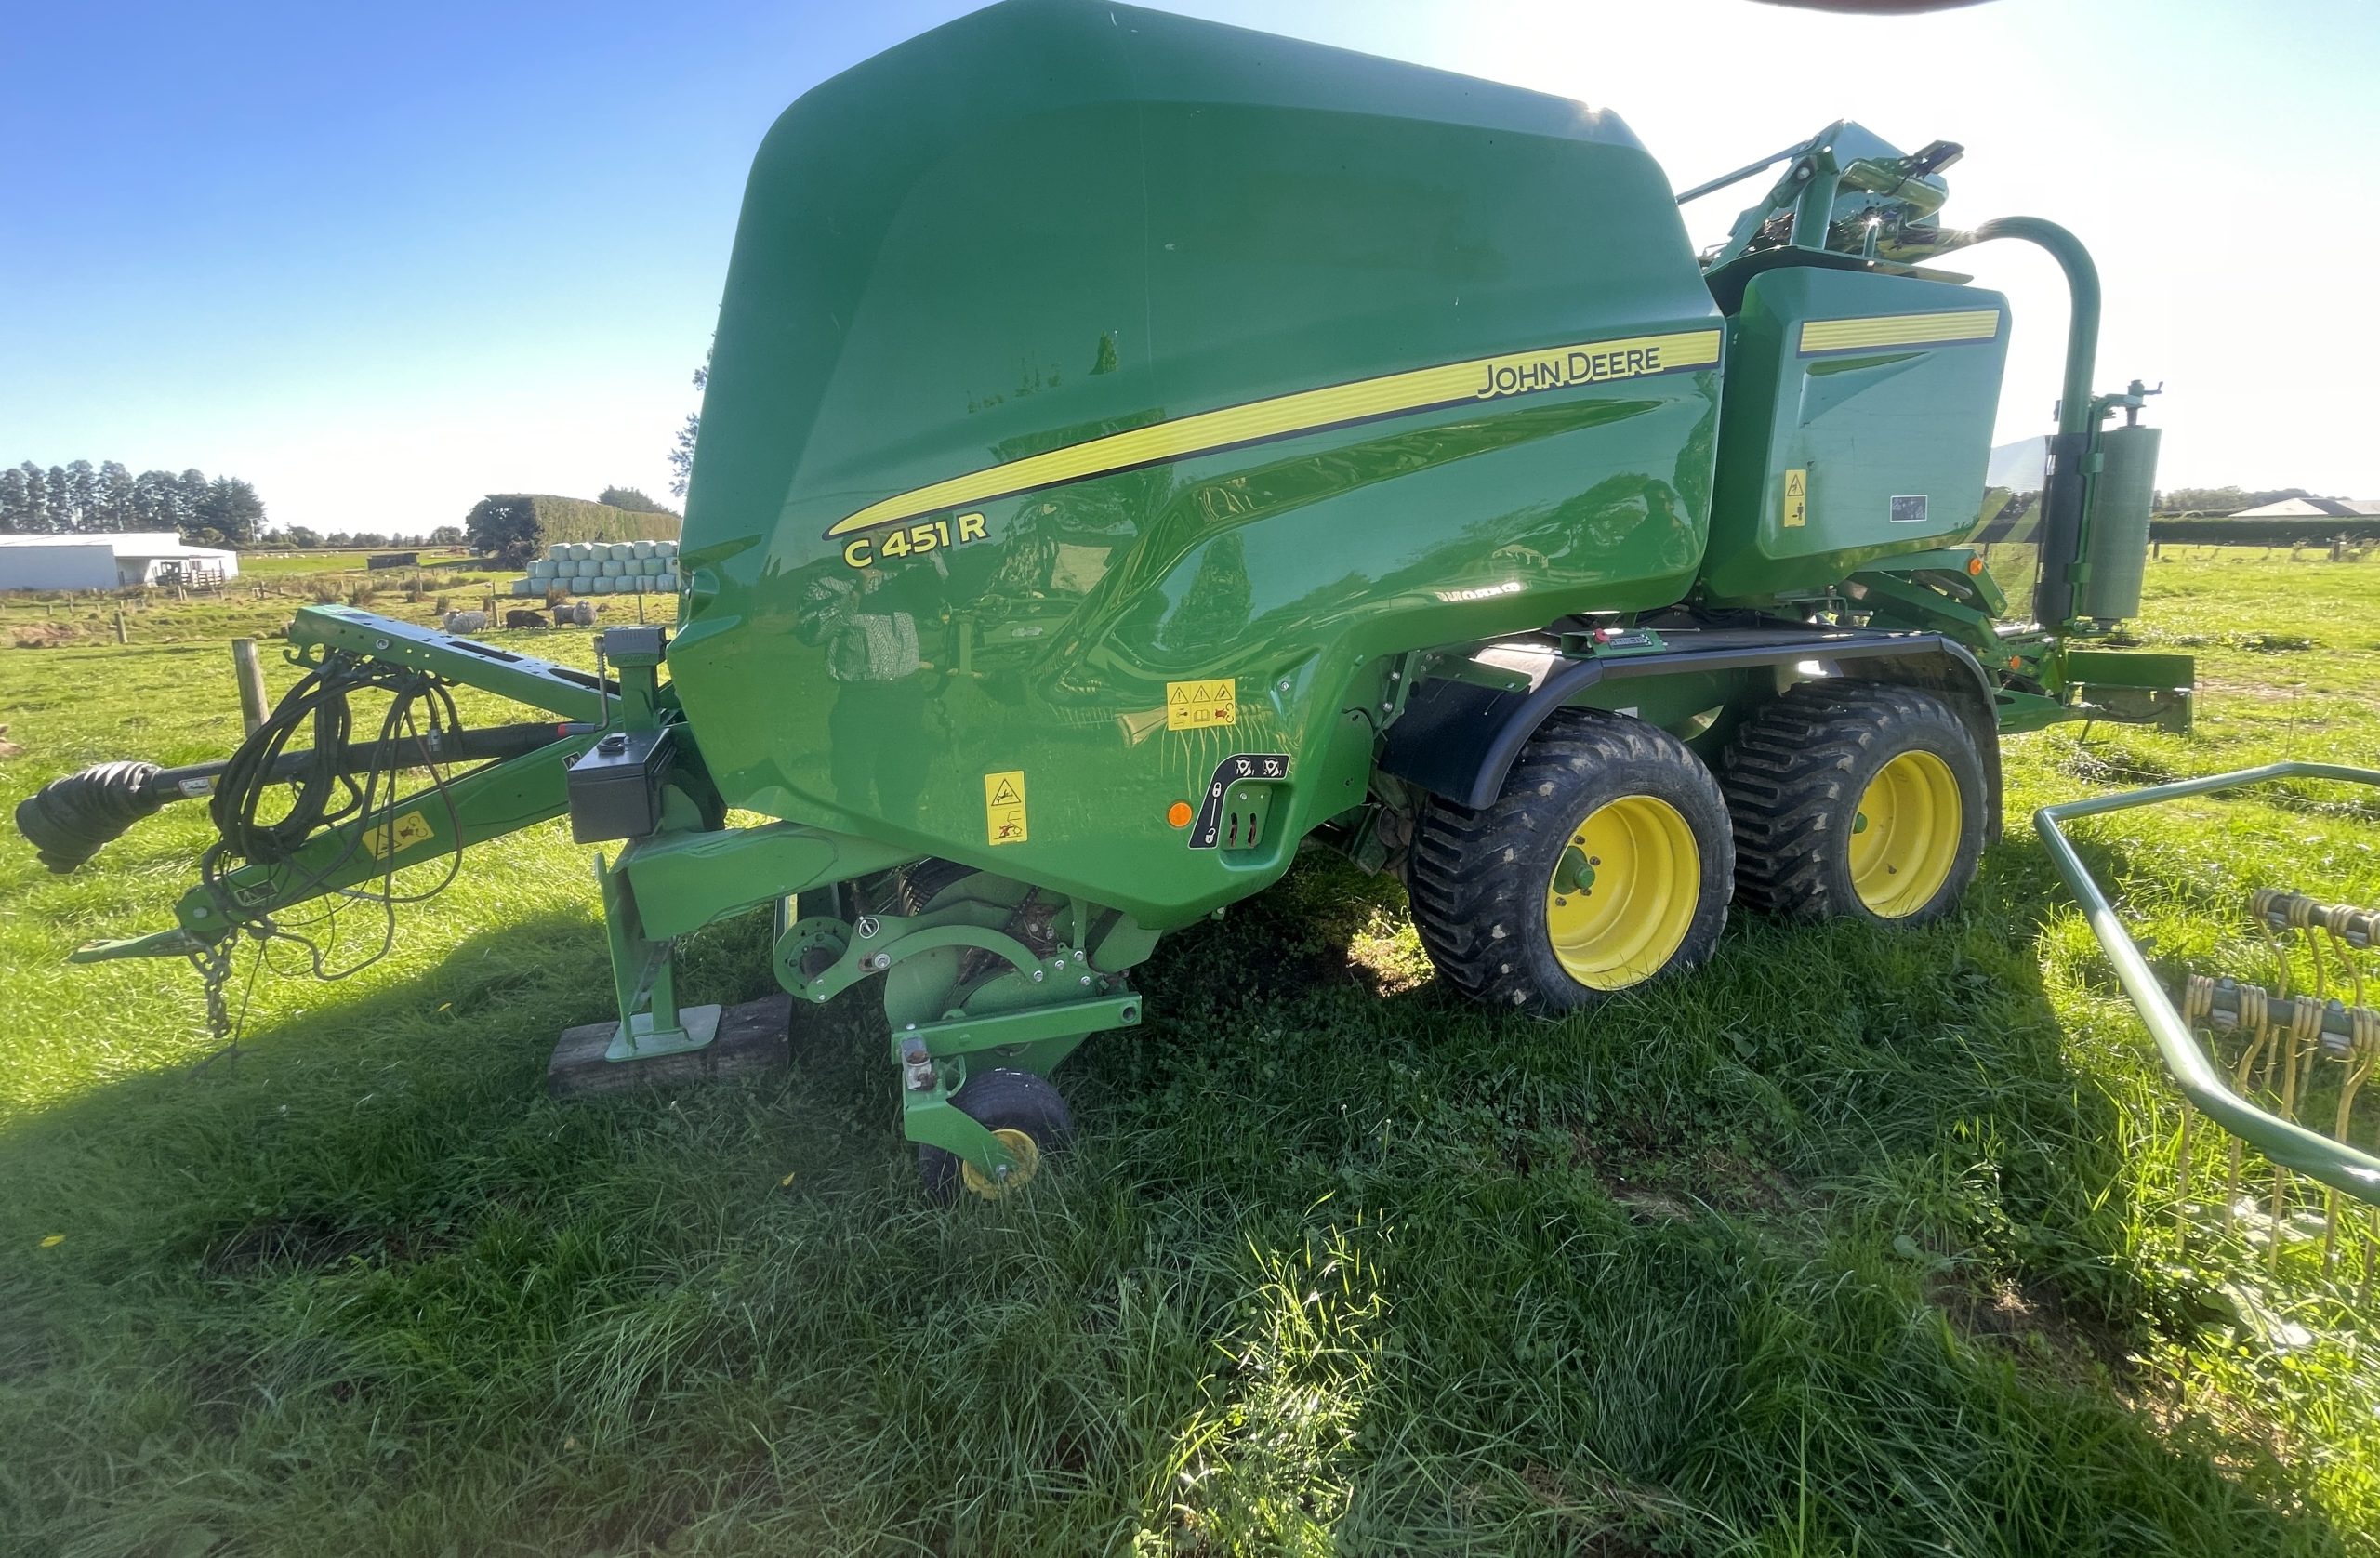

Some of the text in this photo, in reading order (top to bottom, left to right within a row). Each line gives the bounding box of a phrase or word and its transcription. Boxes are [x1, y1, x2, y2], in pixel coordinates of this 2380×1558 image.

[1477, 347, 1662, 396] JOHN DEERE
[843, 512, 990, 568] C 451 R
